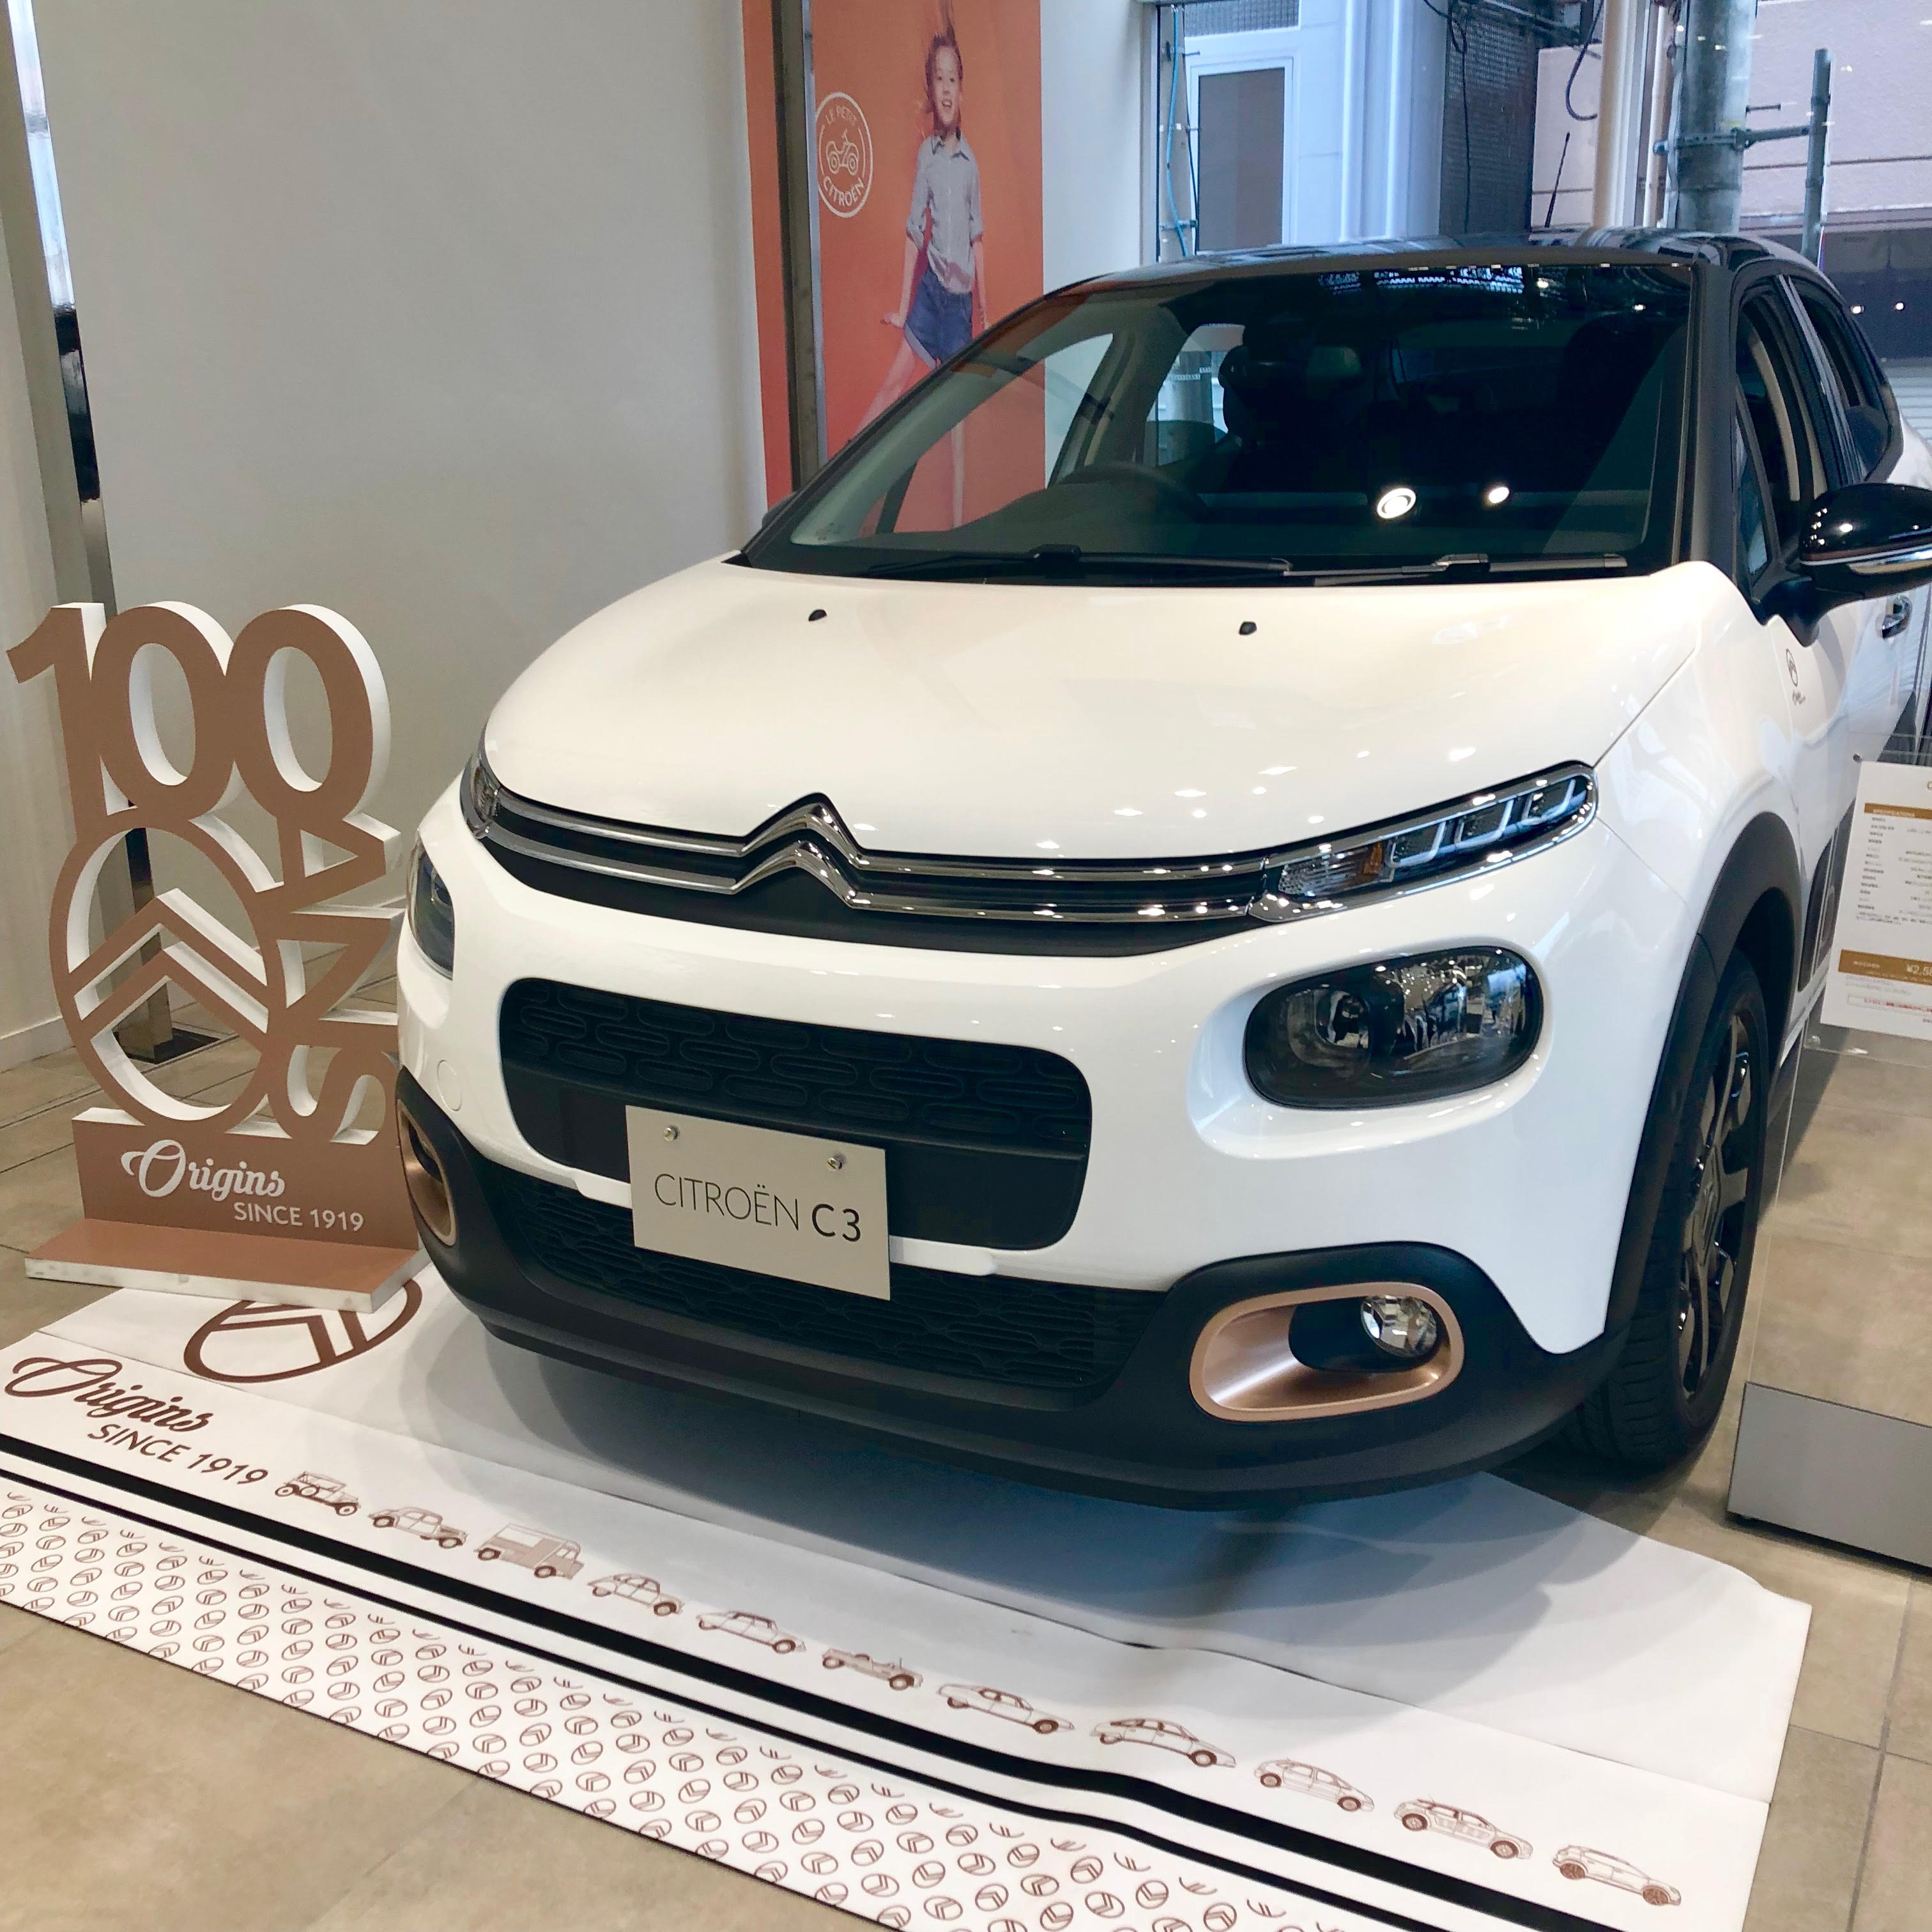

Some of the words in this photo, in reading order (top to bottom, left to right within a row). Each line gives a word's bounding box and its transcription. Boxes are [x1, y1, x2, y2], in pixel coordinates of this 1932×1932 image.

[823, 176, 865, 207] CITROËN
[6, 604, 377, 824] 100
[120, 1139, 286, 1201] Origins
[234, 1202, 303, 1227] SINCE
[309, 1209, 364, 1231] 1919
[654, 1173, 799, 1231] CITROËN
[811, 1204, 861, 1243] C3
[4, 1357, 214, 1432] Origins
[87, 1423, 191, 1462] SINCE
[187, 1453, 269, 1486] 1919
